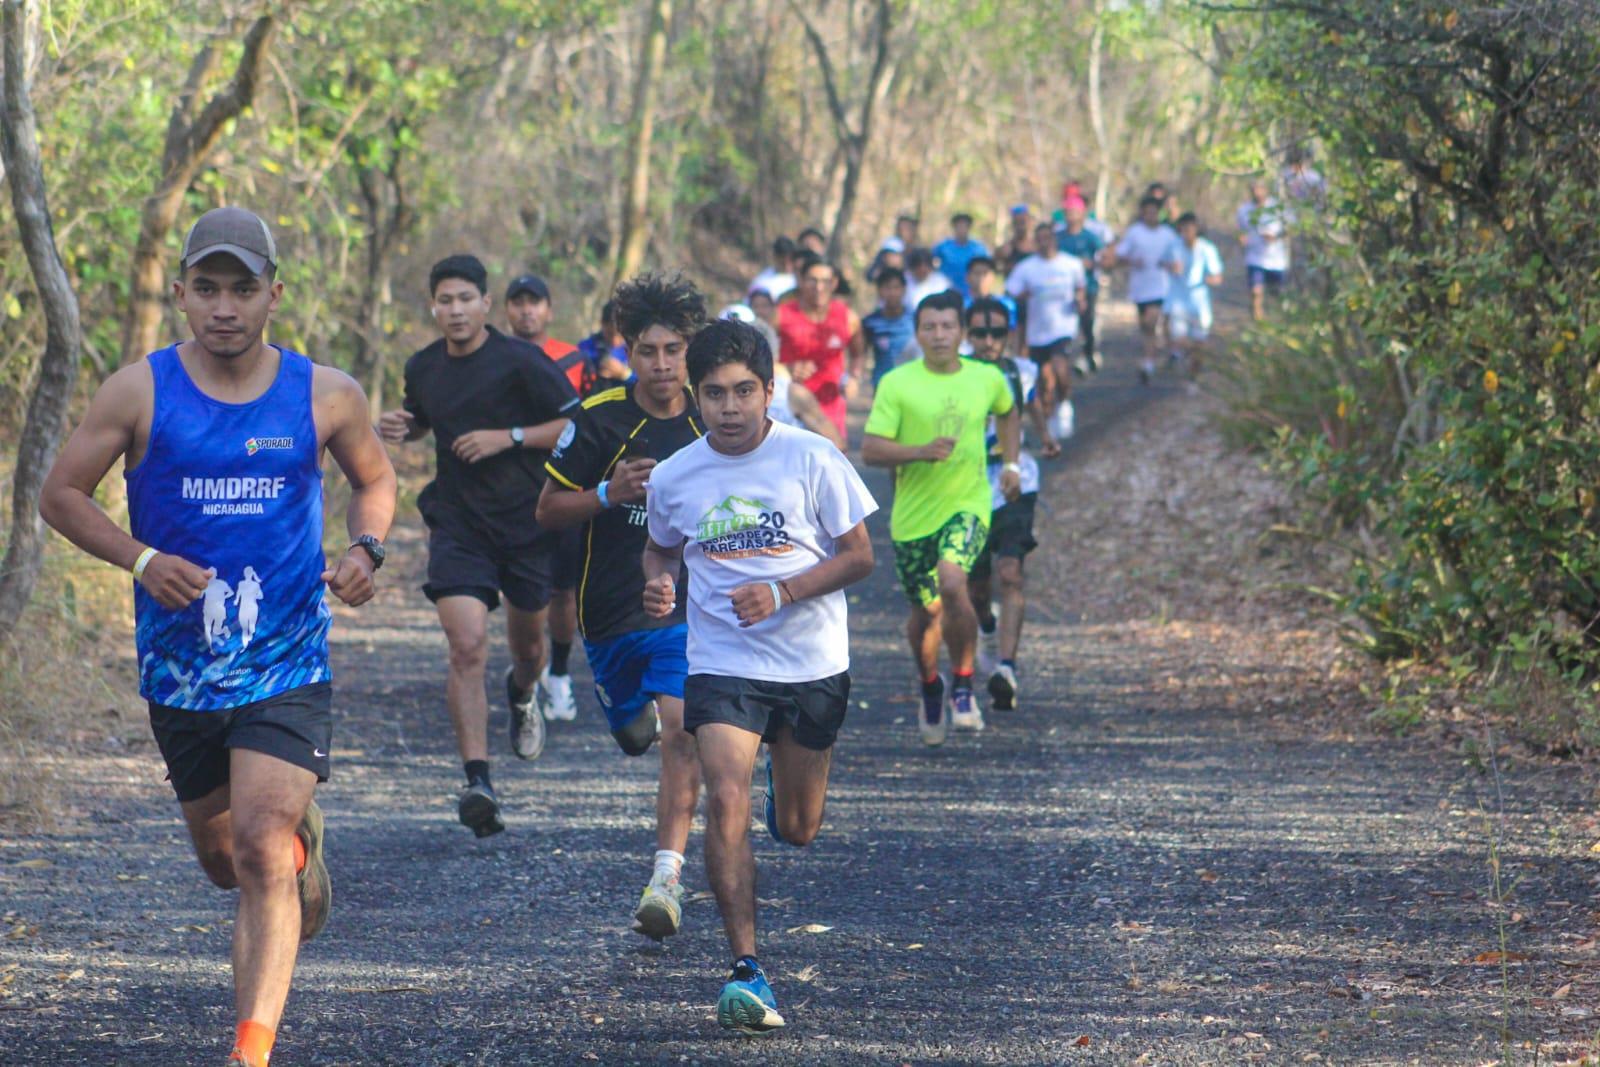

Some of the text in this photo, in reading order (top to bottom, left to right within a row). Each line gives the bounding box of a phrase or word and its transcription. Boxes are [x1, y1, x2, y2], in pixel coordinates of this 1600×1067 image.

[256, 437, 293, 449] SPORADE
[182, 476, 285, 499] MMDRRF
[202, 502, 265, 515] NICARAGUA
[757, 511, 785, 529] 20
[747, 529, 761, 539] DE
[762, 530, 790, 547] 23
[702, 538, 764, 553] PAREJAS
